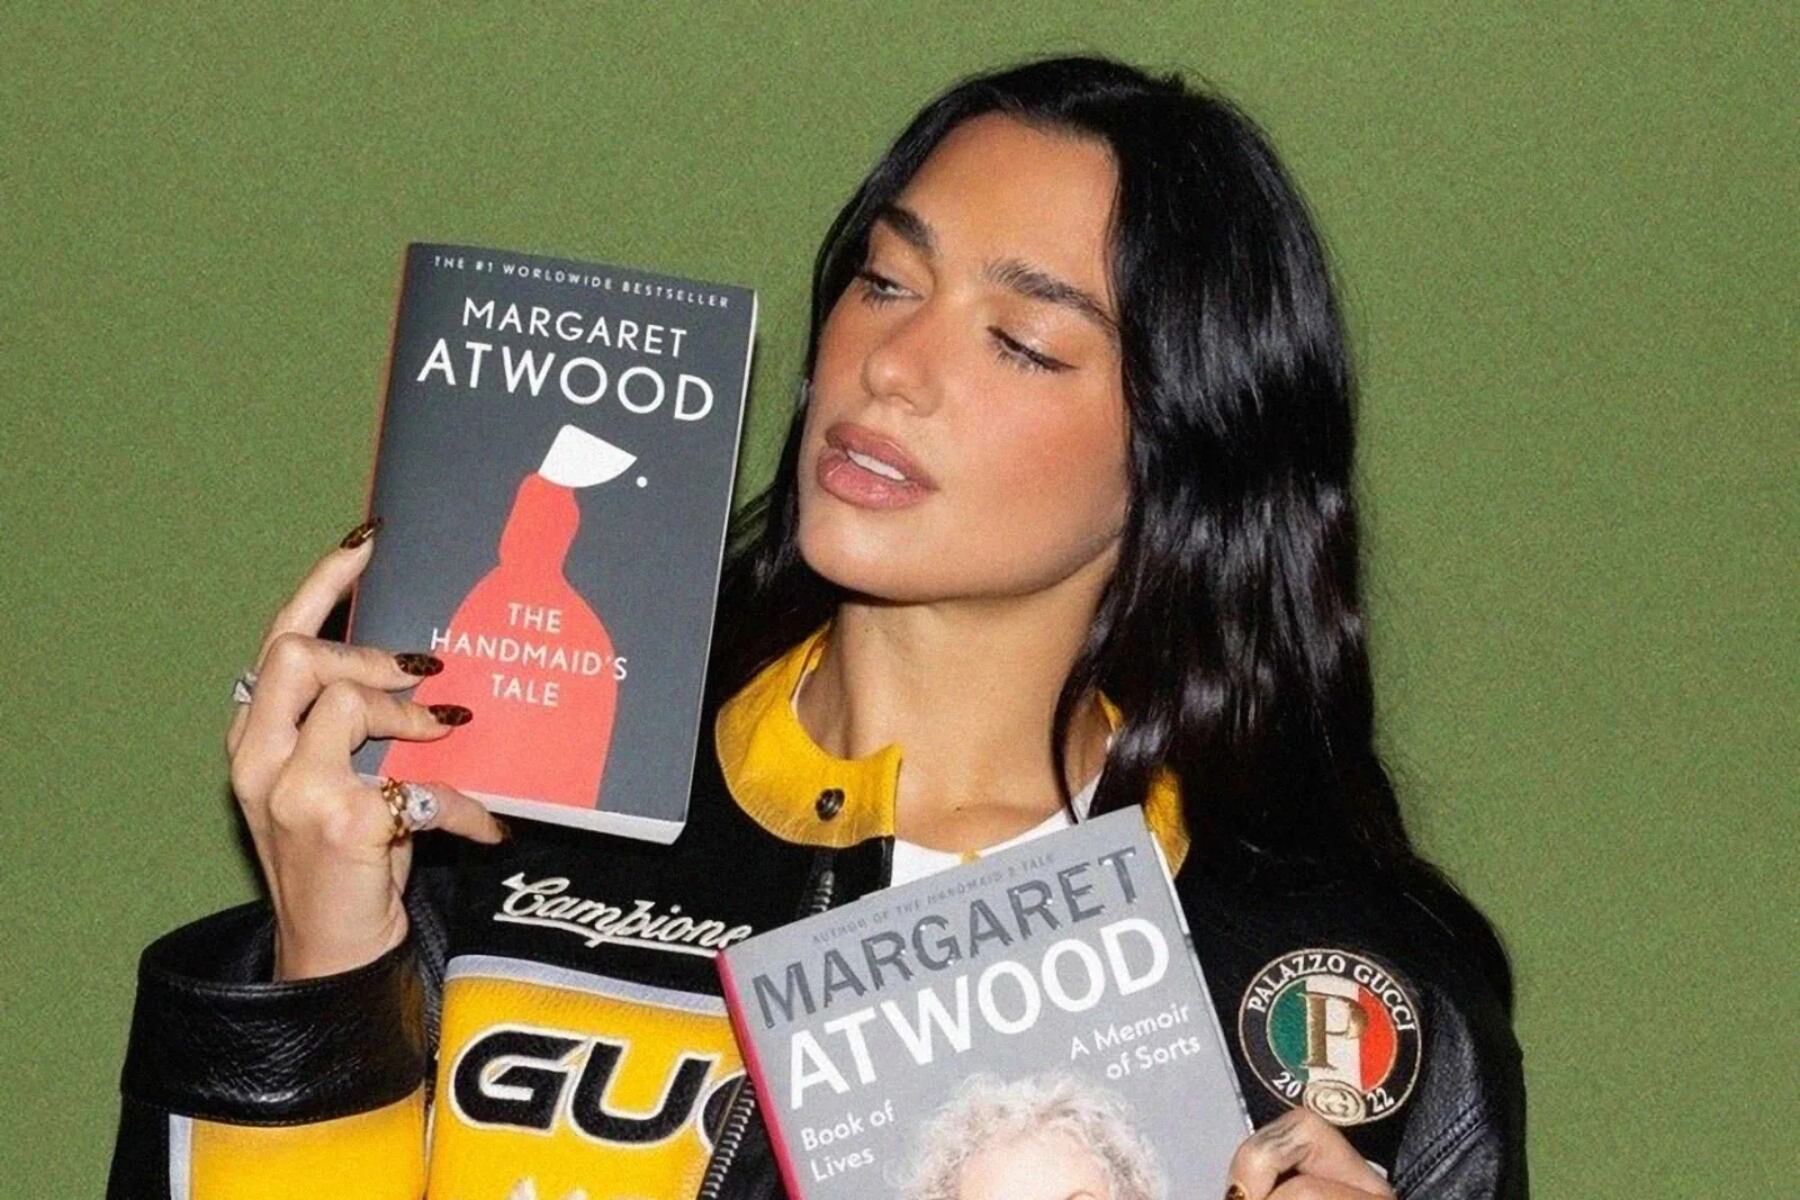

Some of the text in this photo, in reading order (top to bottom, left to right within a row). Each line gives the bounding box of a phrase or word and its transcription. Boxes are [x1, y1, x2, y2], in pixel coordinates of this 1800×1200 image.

[434, 255, 729, 309] THE #1 WORLDWIDE BESTSELLER
[462, 297, 687, 359] MARGARET
[416, 338, 714, 421] ATWOOD
[508, 602, 563, 632] THE
[430, 628, 628, 681] HANDMAID'S
[491, 673, 560, 708] TALE
[494, 872, 752, 956] Campione
[752, 846, 1137, 1029] MARGARET
[791, 918, 1170, 1110] ATWOOD
[1247, 954, 1416, 1031] PALAZZO GUCCI
[1070, 1003, 1189, 1060] A Memoir
[1106, 1037, 1200, 1079] of Sorts
[801, 1099, 894, 1151] Book of
[811, 1148, 875, 1182] Lives
